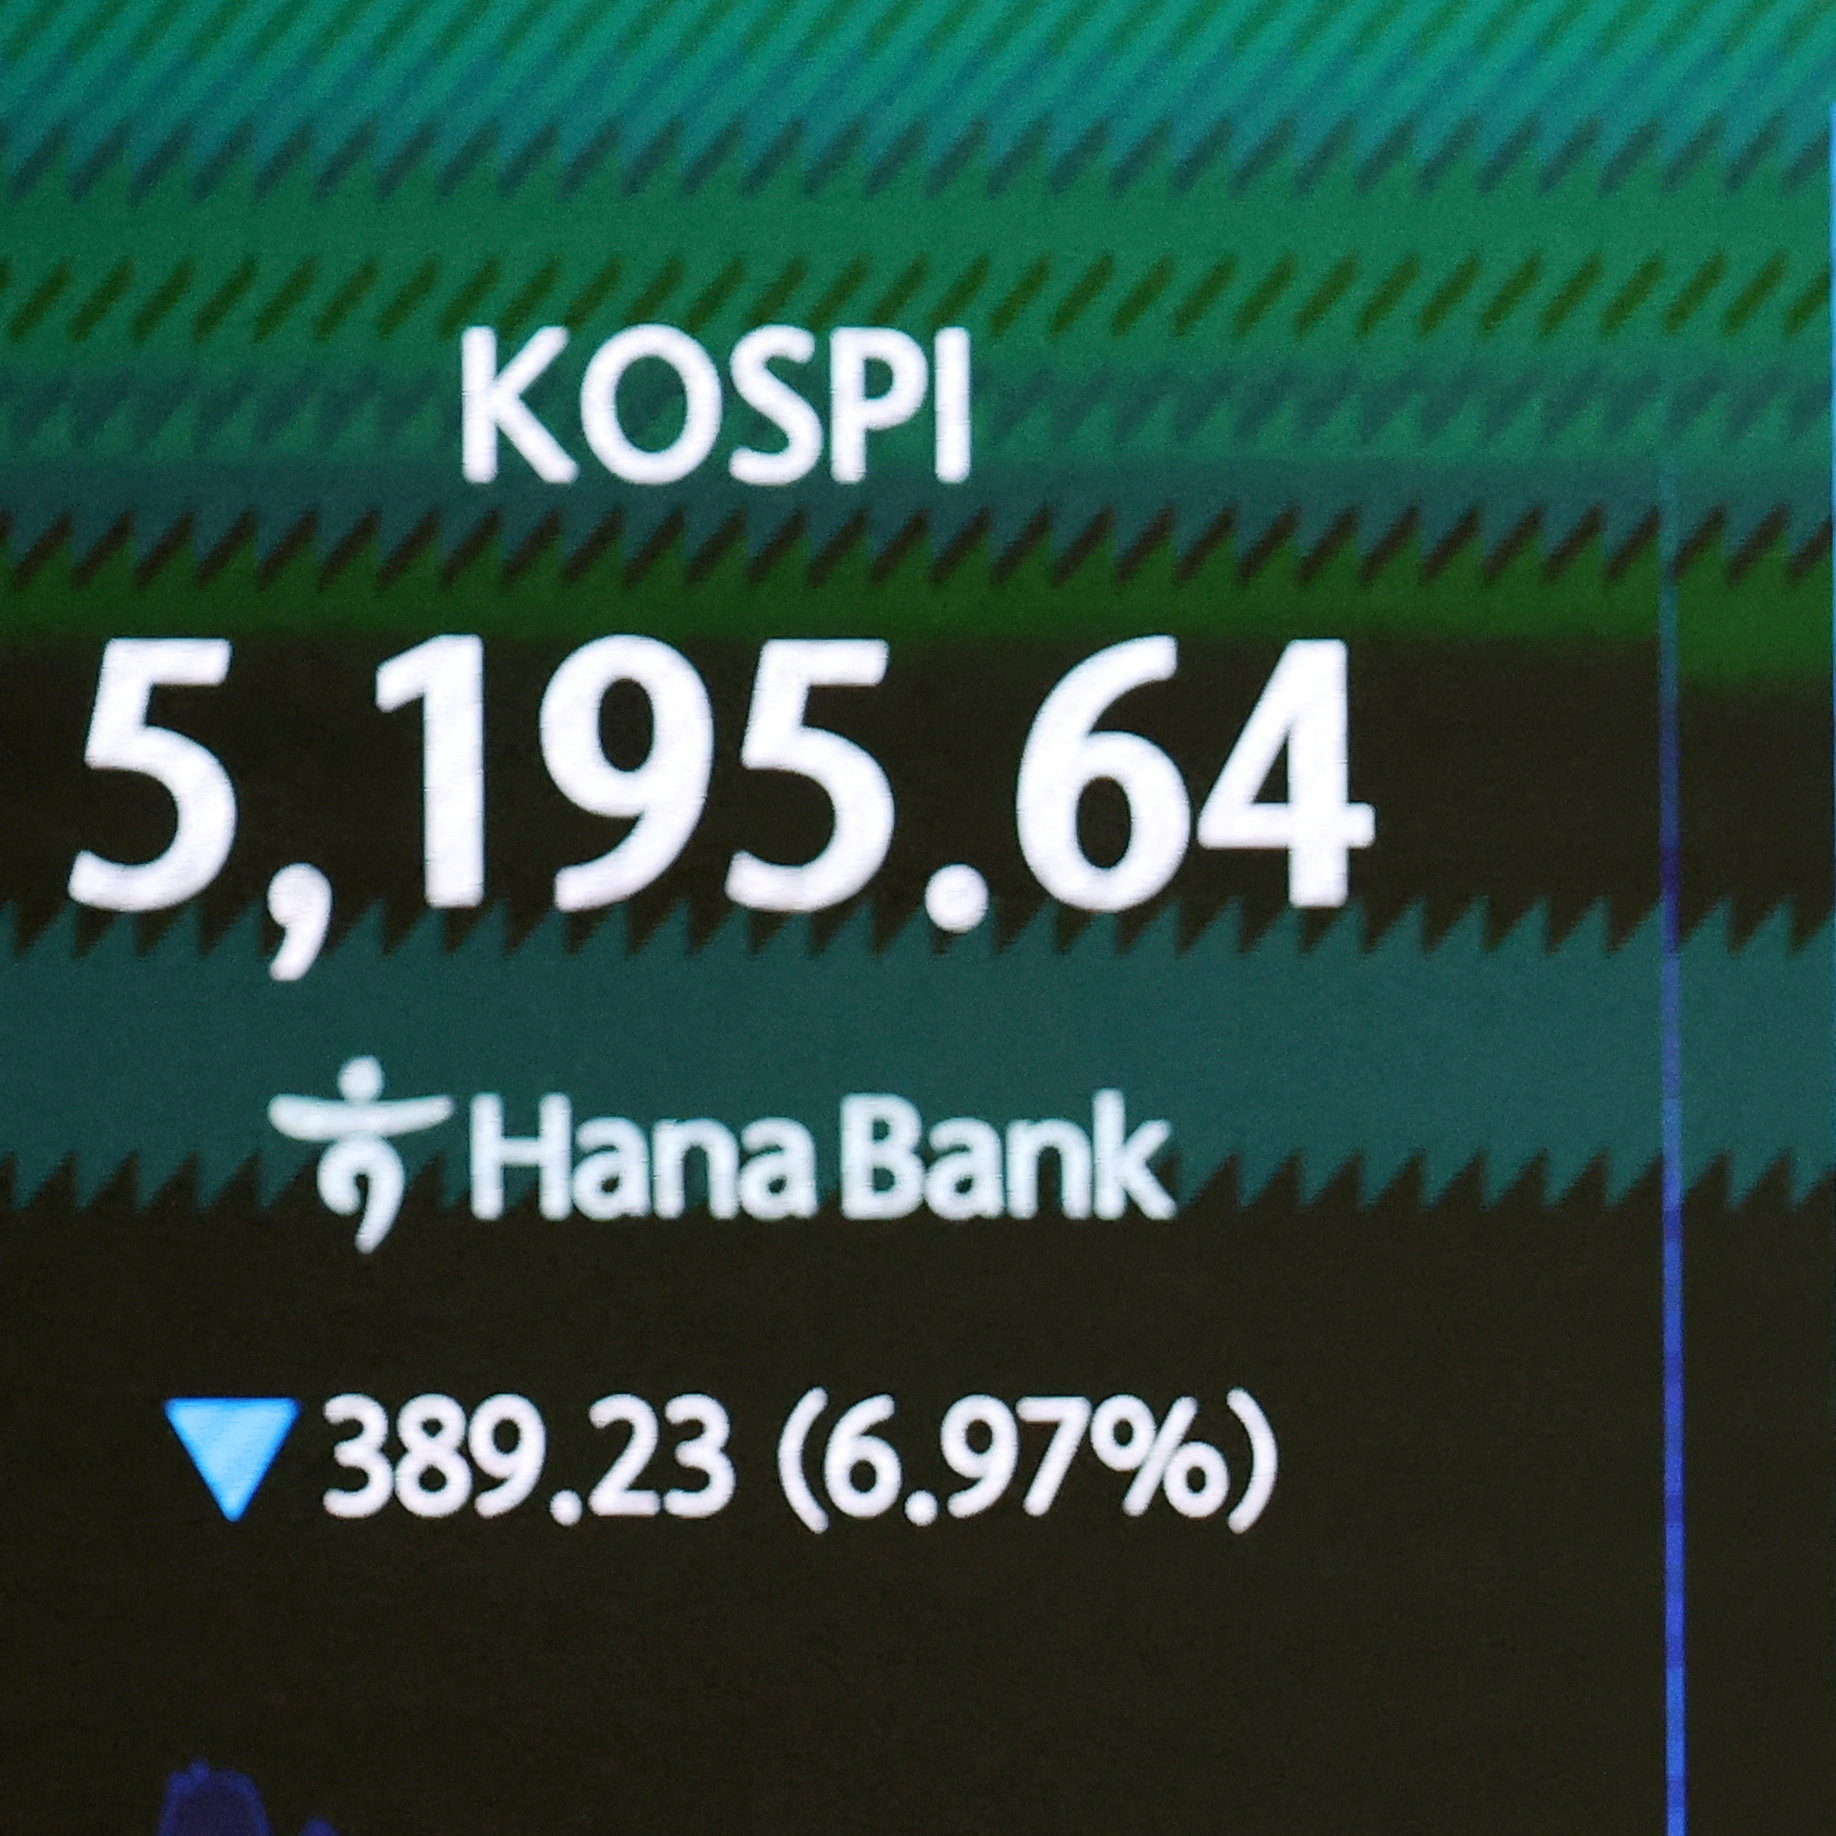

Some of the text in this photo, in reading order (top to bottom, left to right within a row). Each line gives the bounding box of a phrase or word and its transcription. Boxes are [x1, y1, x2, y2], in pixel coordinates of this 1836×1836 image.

[461, 325, 971, 485] KOSPI
[69, 635, 1375, 980] 5,195.64
[471, 1090, 1173, 1220] Hana Bank
[323, 1388, 1278, 1533] 389.23 (6.97%)
